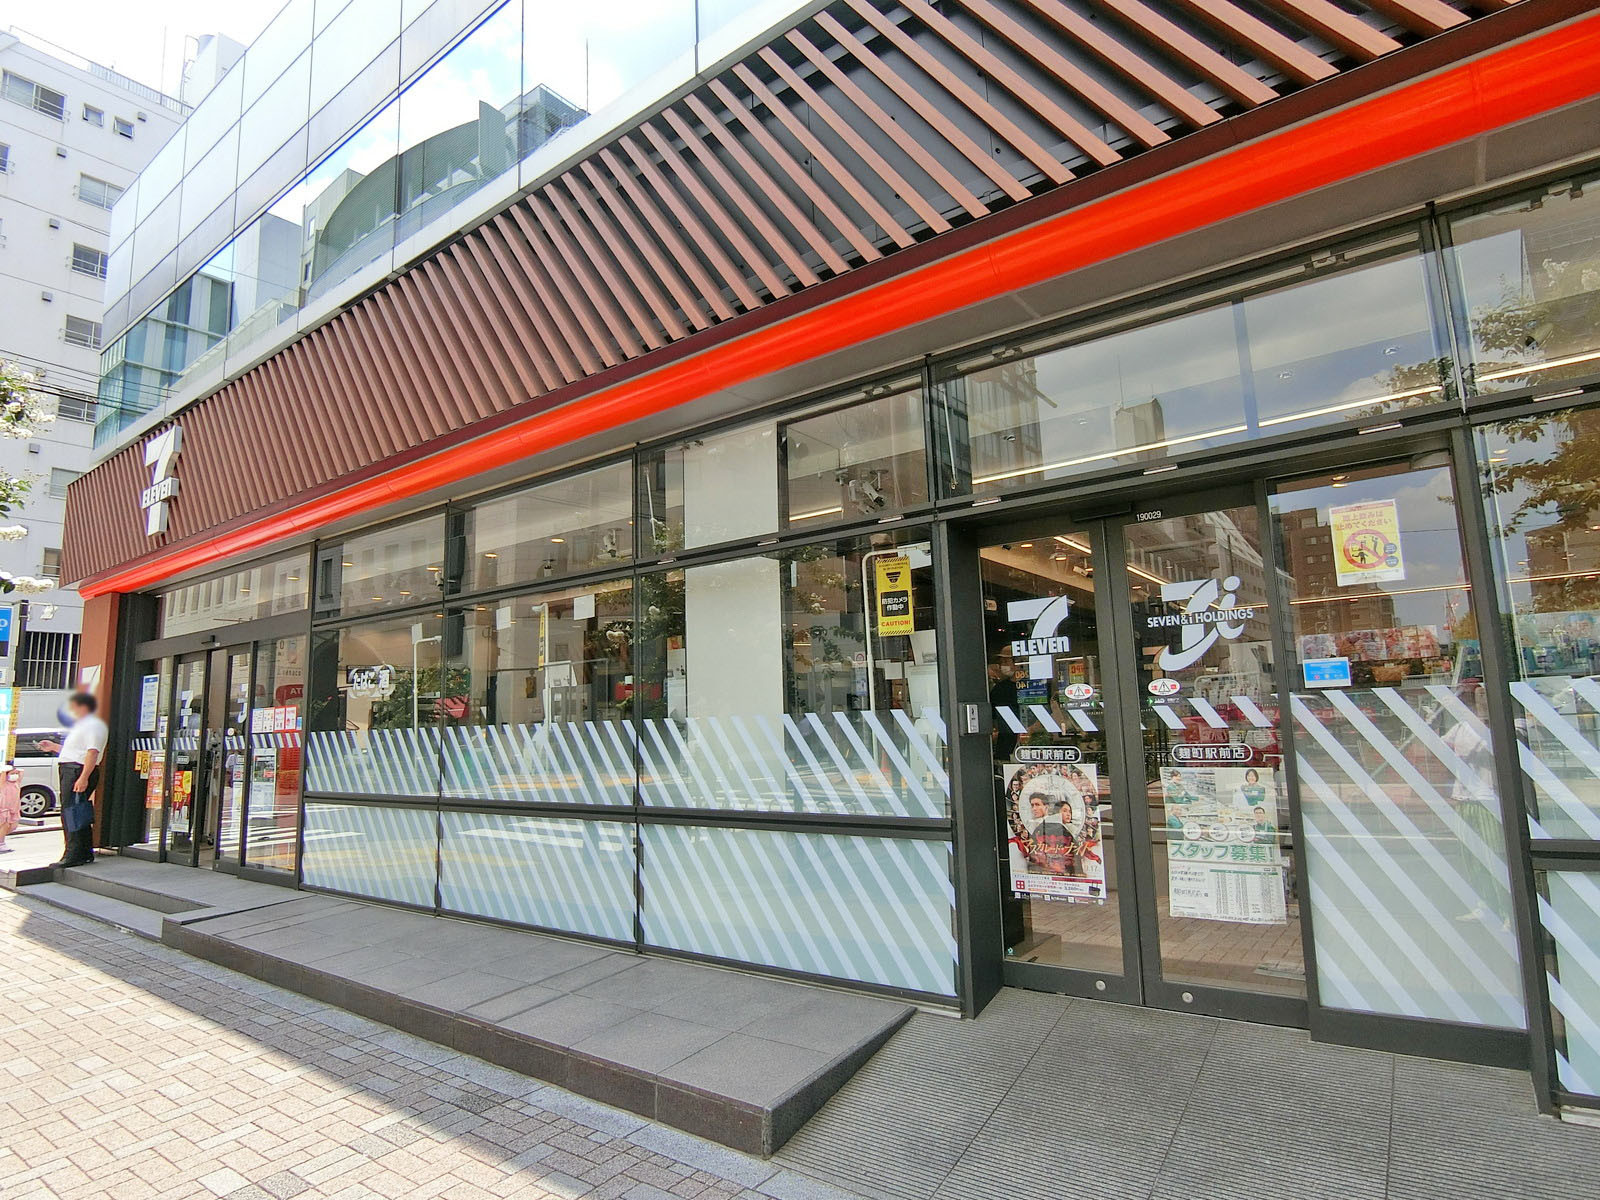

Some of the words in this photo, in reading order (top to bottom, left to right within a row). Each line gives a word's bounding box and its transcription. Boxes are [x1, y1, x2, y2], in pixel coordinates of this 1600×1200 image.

[1136, 510, 1162, 522] 190029
[882, 597, 908, 605] 防犯カメラ
[1147, 614, 1193, 628] SEVEN&i
[1195, 609, 1254, 623] HOLDINGS
[881, 619, 911, 627] CAUTION!
[289, 687, 304, 695] AT
